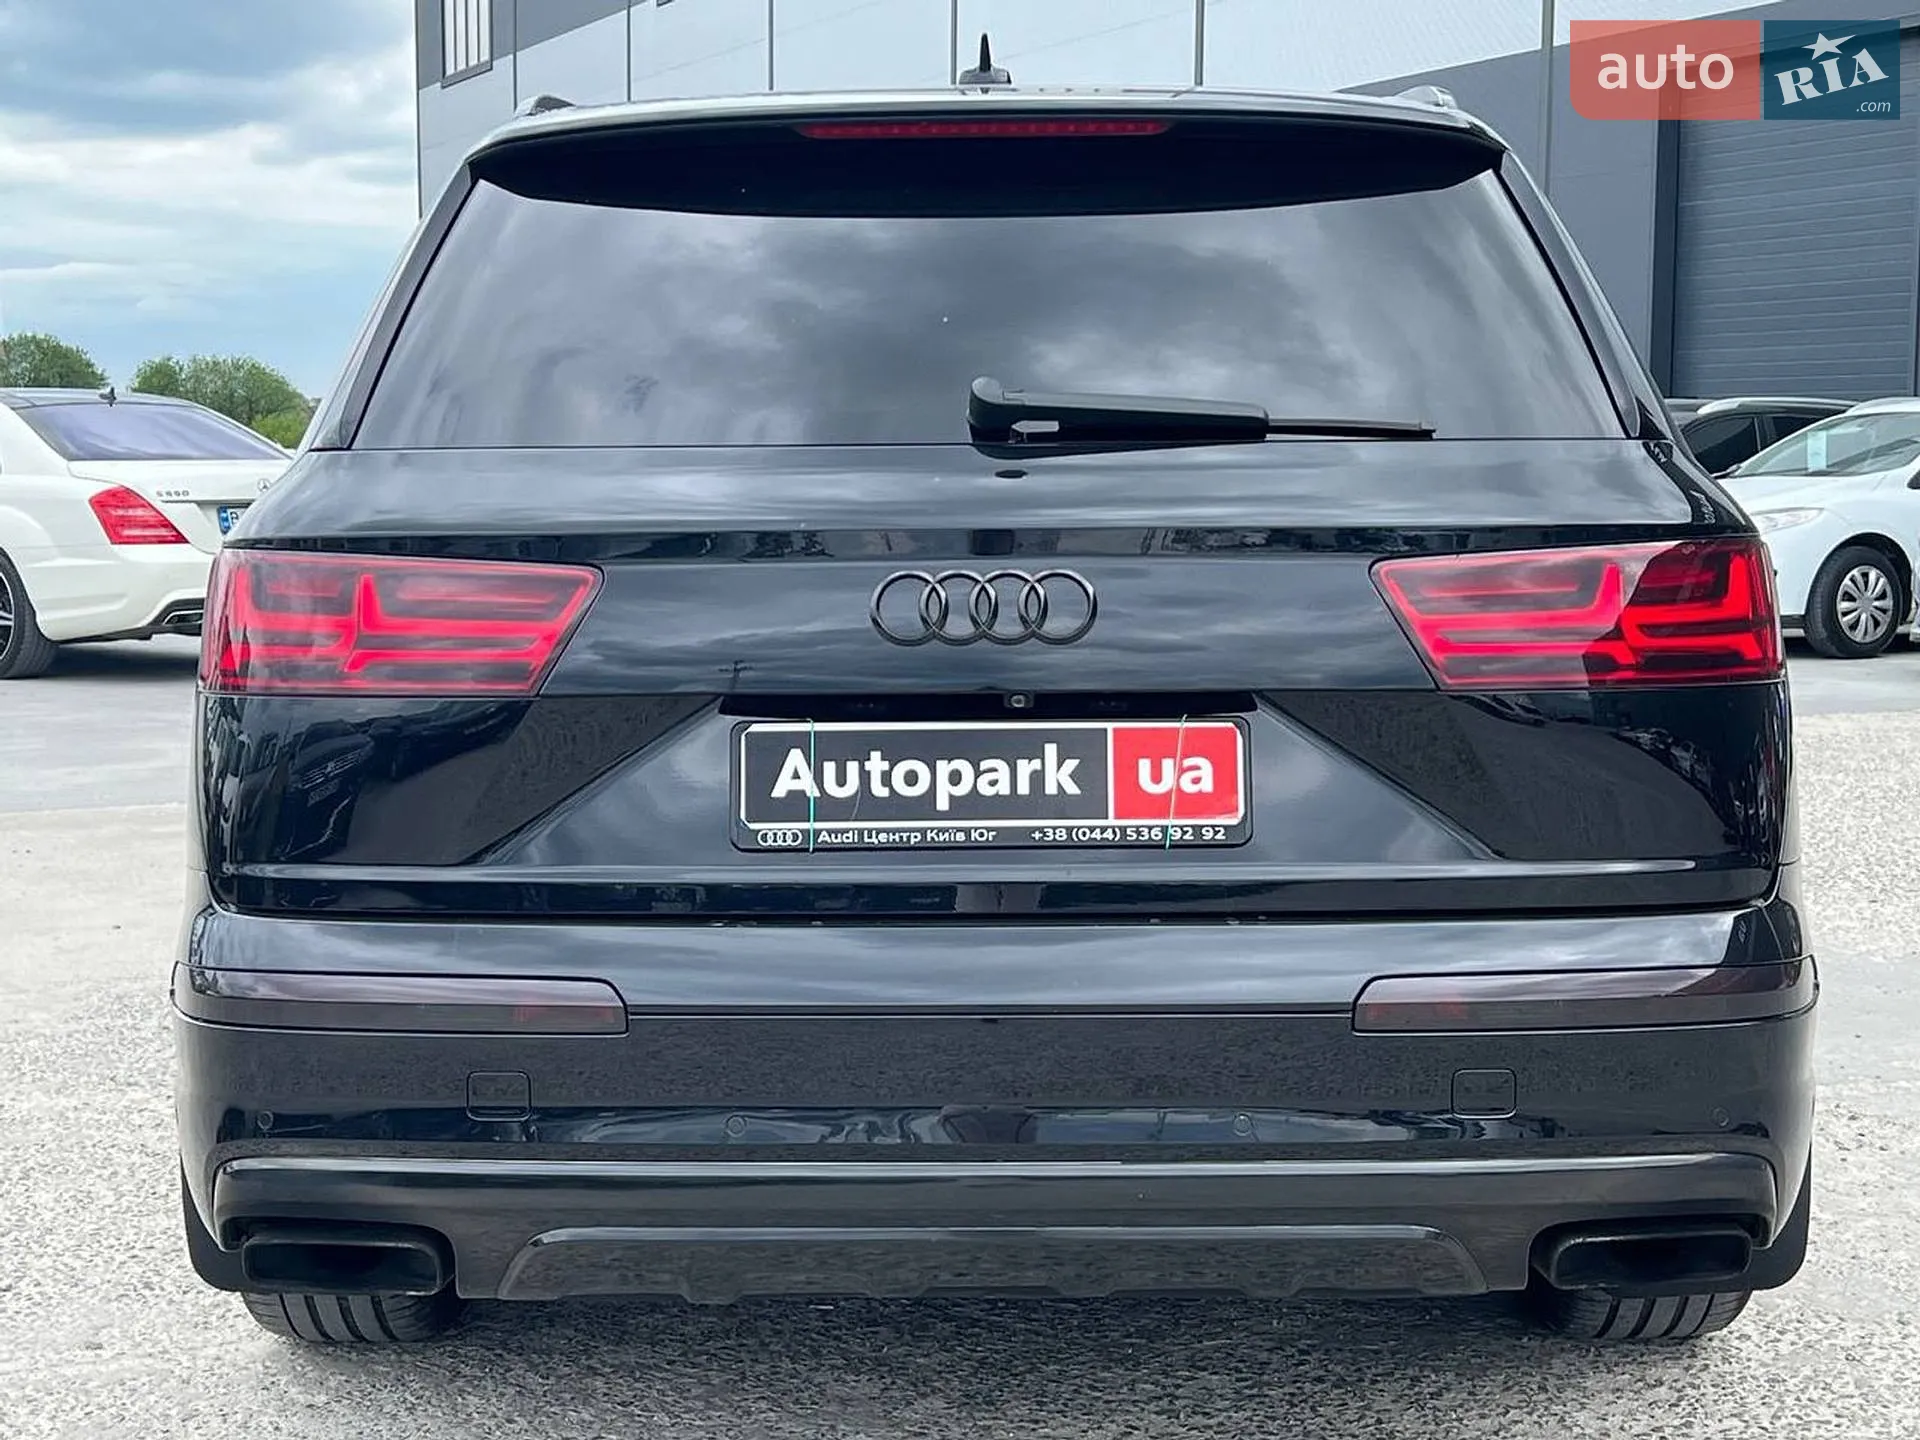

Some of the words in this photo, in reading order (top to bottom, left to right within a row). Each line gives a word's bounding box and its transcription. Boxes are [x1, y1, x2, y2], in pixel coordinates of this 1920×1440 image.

[770, 742, 1082, 812] Autopark
[1137, 755, 1214, 794] ua
[817, 829, 859, 844] Audi
[863, 830, 922, 846] Центр
[926, 827, 966, 843] Київ
[970, 828, 997, 842] Юг
[1031, 827, 1068, 842] +38
[1071, 826, 1121, 842] (044)
[1126, 826, 1163, 841] 536
[1170, 826, 1195, 840] 92
[1201, 826, 1227, 840] 92
